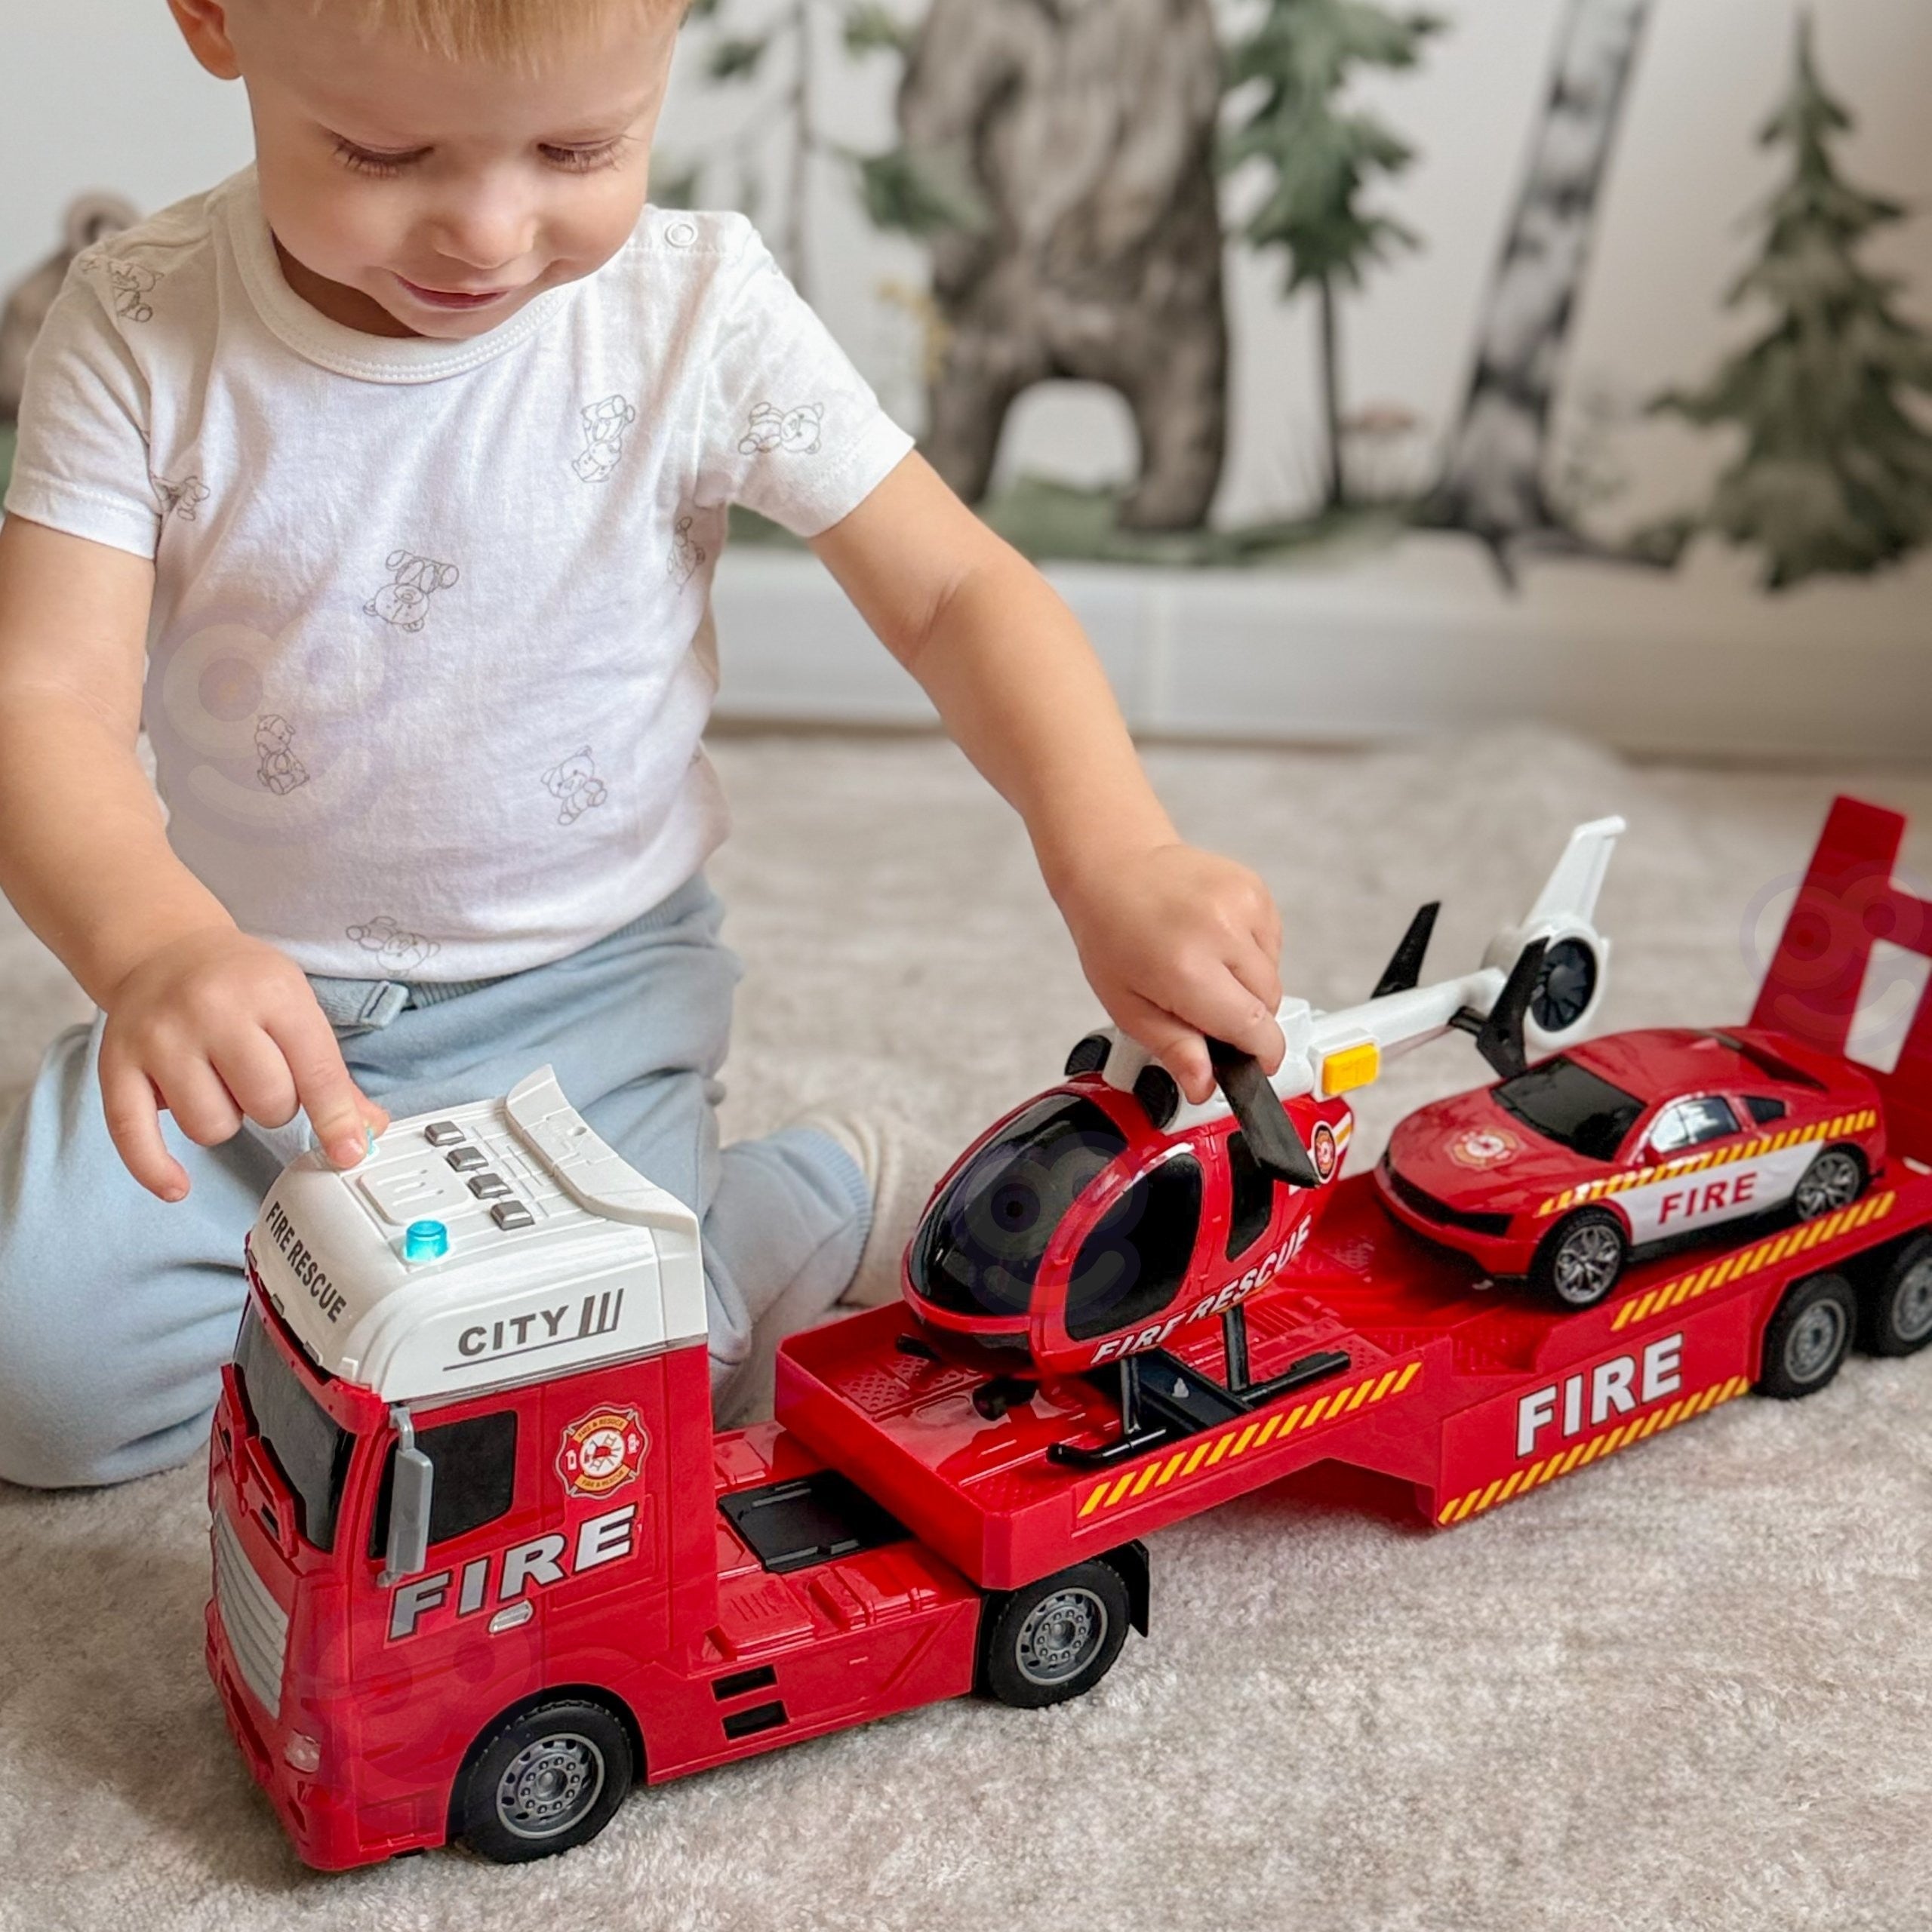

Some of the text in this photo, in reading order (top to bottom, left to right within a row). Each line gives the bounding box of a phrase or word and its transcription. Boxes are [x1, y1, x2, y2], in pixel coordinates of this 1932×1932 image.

[1658, 1174, 1757, 1225] FIRE
[266, 1201, 347, 1324] FIRE RESCUE
[1186, 1214, 1312, 1324] RESCUE
[458, 1305, 570, 1357] CITY
[1515, 1331, 1684, 1459] FIRE
[387, 1502, 639, 1641] FIRE
